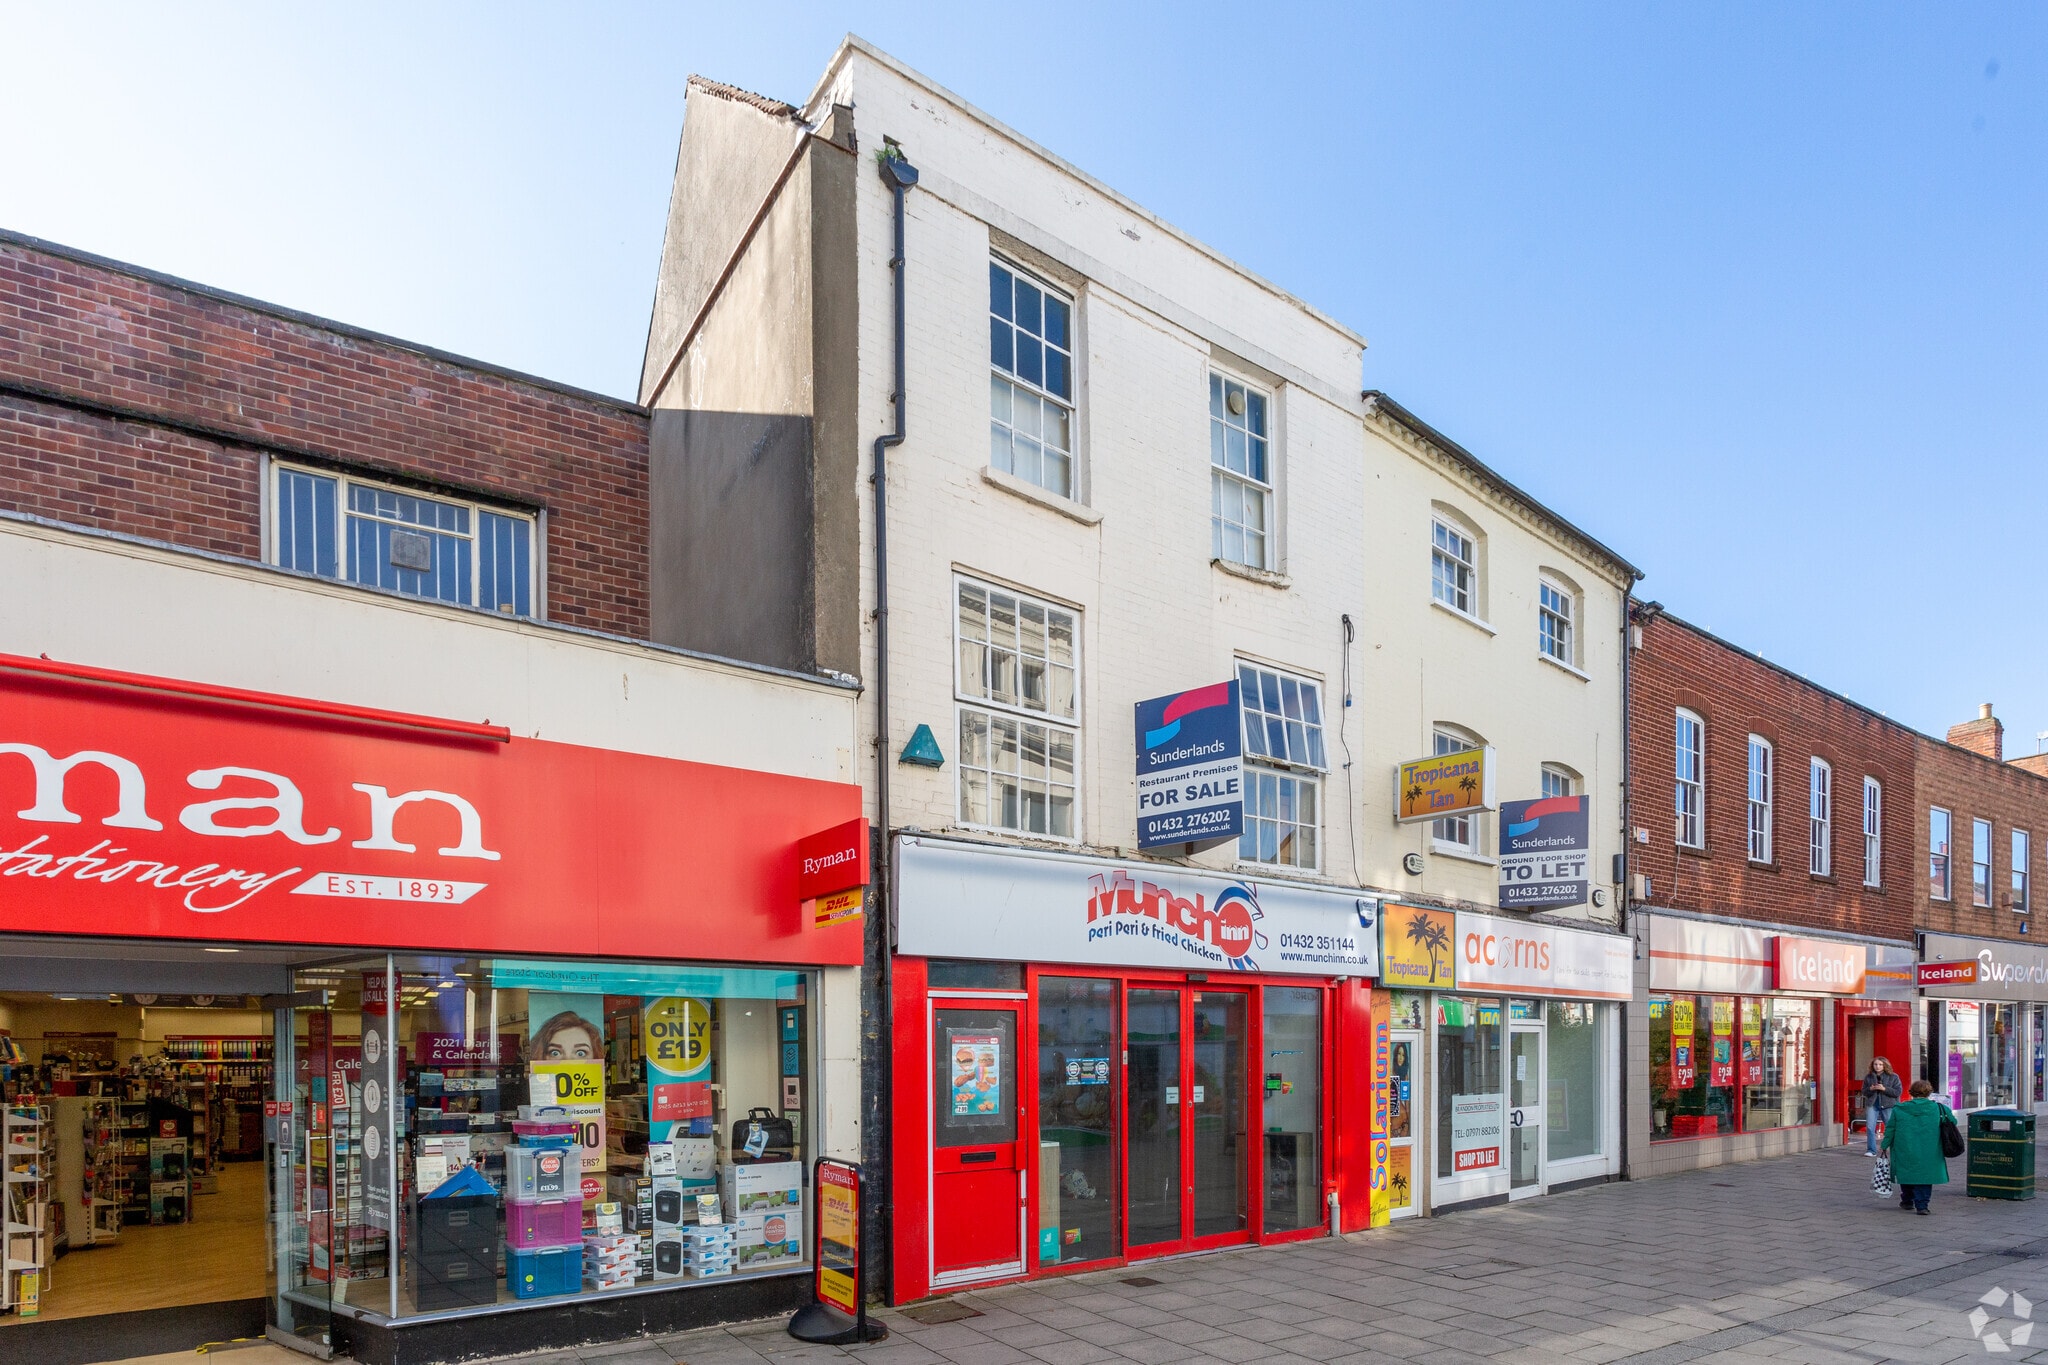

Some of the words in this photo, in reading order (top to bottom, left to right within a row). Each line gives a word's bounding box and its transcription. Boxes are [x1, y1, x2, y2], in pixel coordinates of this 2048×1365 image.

[1150, 739, 1226, 765] Sunderlands
[1139, 772, 1190, 788] Restaurant
[1192, 763, 1239, 779] Premises
[1404, 760, 1480, 786] Tropicana
[1140, 788, 1179, 810] FOR
[1185, 778, 1239, 802] SALE
[1426, 789, 1454, 809] Tan
[1149, 816, 1183, 833] 01432
[1186, 809, 1231, 827] 276202
[1149, 823, 1231, 841] www.sunderlands.co.uk
[1512, 836, 1576, 849] Sunderlands
[803, 847, 856, 874] Ryman
[1501, 857, 1535, 866] GROUND
[1536, 855, 1563, 863] FLOOR
[1564, 854, 1586, 862] SHOP
[0, 835, 301, 912] tationery
[1502, 865, 1533, 881] TO
[1541, 861, 1585, 878] LET
[327, 876, 383, 896] EST.
[397, 880, 456, 900] 1893
[1509, 886, 1538, 898] 01432
[1541, 884, 1578, 895] 276202
[826, 896, 850, 911] DHL
[1508, 894, 1578, 904] www.sunderlands.co.uk
[1087, 870, 1221, 947] Munch
[1220, 918, 1250, 941] inn
[1141, 924, 1149, 936] &
[1181, 939, 1222, 962] Chicken
[1280, 933, 1314, 949] 01432
[1316, 936, 1355, 951] 351144
[1280, 952, 1368, 965] www.munchinn.co.uk
[1465, 931, 1550, 972] acorns
[1386, 955, 1429, 979] Tropicana
[1437, 959, 1452, 979] Tan
[1791, 949, 1855, 984] Iceland
[1921, 967, 1972, 980] Iceland
[366, 976, 381, 989] HELP
[380, 977, 399, 989] KP
[364, 989, 371, 1002] US
[371, 990, 383, 1002] ALL
[383, 990, 400, 1002] SFE
[1674, 1005, 1692, 1022] 50%
[650, 1021, 707, 1038] ONLY
[433, 1037, 460, 1048] 2021
[657, 1039, 702, 1060] £19
[432, 1050, 443, 1060] &
[332, 1086, 345, 1104] £20
[574, 1087, 598, 1098] OFF
[1370, 1020, 1388, 1191] Solarium
[1465, 1127, 1481, 1138] 07971
[581, 1157, 600, 1168] ERS?
[1459, 1152, 1476, 1168] SHOP
[1476, 1151, 1485, 1165] TO
[1485, 1150, 1496, 1164] LET
[823, 1167, 855, 1186] Ryman
